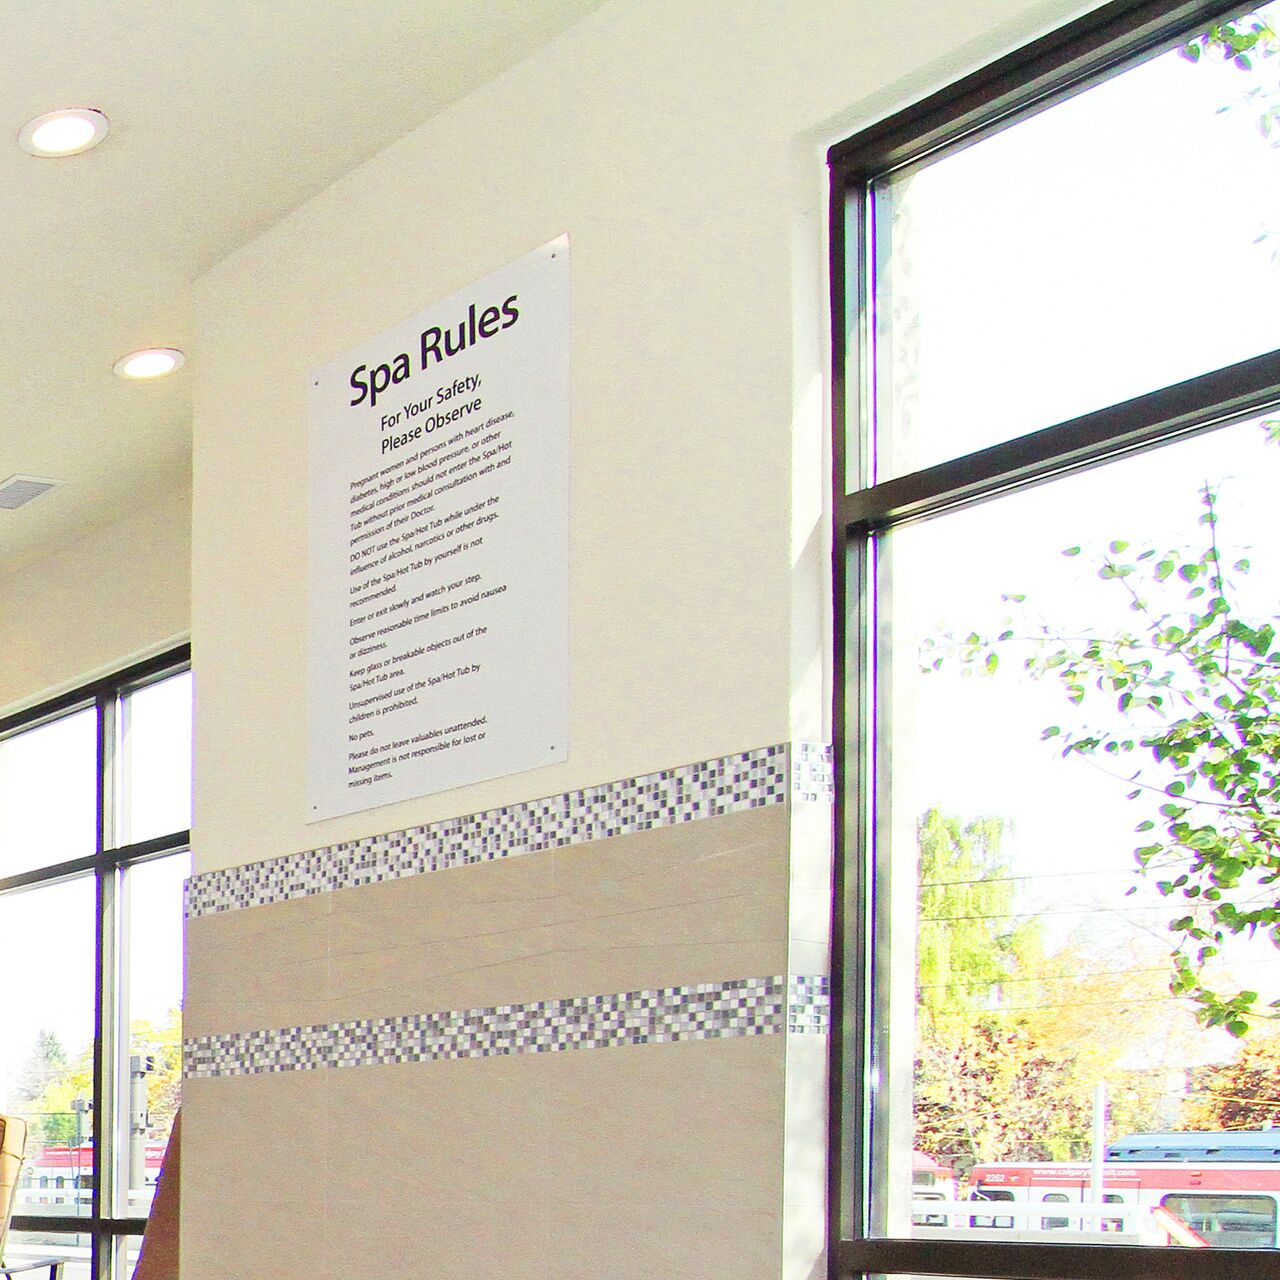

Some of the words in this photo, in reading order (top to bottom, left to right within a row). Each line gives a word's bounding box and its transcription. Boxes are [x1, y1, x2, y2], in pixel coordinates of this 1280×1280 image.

[349, 352, 410, 407] Spa
[420, 294, 519, 370] Rules
[381, 412, 401, 431] For
[404, 396, 434, 419] Your
[436, 373, 481, 404] Safety,
[381, 426, 421, 454] Please
[424, 398, 482, 433] Observe
[349, 471, 379, 490] Pregnant
[379, 460, 404, 476] women
[404, 451, 418, 465] and
[419, 440, 446, 460] persons
[447, 431, 464, 445] with
[464, 422, 484, 438] heart
[485, 410, 515, 428] disease,
[349, 487, 378, 504] diabetes,
[379, 478, 394, 490] high
[395, 475, 403, 484] or
[403, 469, 416, 480] low
[417, 457, 438, 474] blood
[438, 445, 470, 466] pressure,
[471, 440, 479, 449] or
[480, 430, 501, 445] other
[349, 500, 375, 518] medical
[375, 486, 410, 507] conditions
[410, 473, 434, 491] should
[435, 469, 447, 480] not
[448, 460, 467, 474] enter
[468, 455, 481, 466] the
[349, 520, 362, 531] Tub
[363, 509, 388, 526] without
[389, 502, 405, 516] prior
[406, 488, 433, 507] medical
[433, 471, 478, 495] consultation
[478, 463, 495, 476] with
[495, 454, 511, 469] and
[349, 525, 385, 547] permission
[385, 519, 393, 530] of
[393, 515, 409, 527] their
[410, 504, 435, 520] Doctor.
[349, 551, 360, 563] DO
[361, 544, 375, 558] NOT
[376, 541, 388, 552] use
[388, 536, 400, 546] the
[429, 518, 443, 529] Tub
[443, 510, 463, 524] while
[463, 500, 485, 516] under
[486, 495, 499, 506] the
[349, 559, 379, 576] influence
[379, 554, 387, 564] of
[387, 544, 413, 561] alcohol,
[414, 532, 445, 550] narcotics
[446, 528, 454, 538] or
[455, 520, 474, 534] other
[475, 511, 499, 526] drugs.
[349, 585, 362, 594] Use
[362, 579, 370, 590] of
[370, 577, 381, 587] the
[409, 560, 423, 571] Tub
[423, 557, 433, 566] by
[434, 543, 462, 564] yourself
[462, 542, 469, 550] is
[470, 536, 483, 548] not
[349, 583, 397, 608] recommended.
[349, 615, 366, 627] Enter
[367, 612, 375, 620] or
[375, 606, 388, 617] exit
[388, 598, 409, 613] slowly
[410, 592, 424, 605] and
[425, 584, 446, 599] watch
[446, 579, 463, 593] your
[464, 573, 482, 585] step.
[349, 631, 376, 646] Observe
[376, 617, 413, 636] reasonable
[413, 612, 429, 623] time
[430, 605, 449, 617] limits
[450, 601, 458, 610] to
[459, 591, 480, 607] avoid
[480, 584, 507, 599] nausea
[348, 651, 356, 660] or
[357, 641, 388, 657] dizziness.
[348, 667, 365, 678] Keep
[366, 661, 382, 674] glass
[383, 658, 390, 667] or
[391, 646, 425, 664] breakable
[425, 638, 451, 652] objects
[452, 632, 465, 644] out
[465, 628, 474, 639] of
[475, 626, 487, 636] the
[375, 672, 388, 683] Tub
[389, 668, 405, 679] area.
[348, 689, 392, 710] Unsupervised
[393, 687, 405, 696] use
[406, 682, 414, 692] of
[414, 680, 426, 690] the
[456, 665, 470, 676] Tub
[471, 663, 481, 673] by
[348, 710, 374, 724] children
[375, 708, 381, 716] is
[381, 695, 418, 716] prohibited.
[347, 757, 390, 775] Management
[398, 751, 410, 761] not
[410, 740, 450, 758] responsible
[451, 737, 462, 747] for
[463, 733, 476, 744] lost
[477, 731, 486, 740] or
[348, 733, 358, 742] No
[358, 729, 375, 741] pets.
[348, 750, 368, 761] Please
[369, 746, 378, 755] do
[379, 743, 391, 752] not
[391, 738, 409, 749] leave
[410, 729, 443, 744] valuables
[444, 715, 488, 734] unattended.
[347, 776, 372, 788] missing
[373, 771, 393, 782] items.
